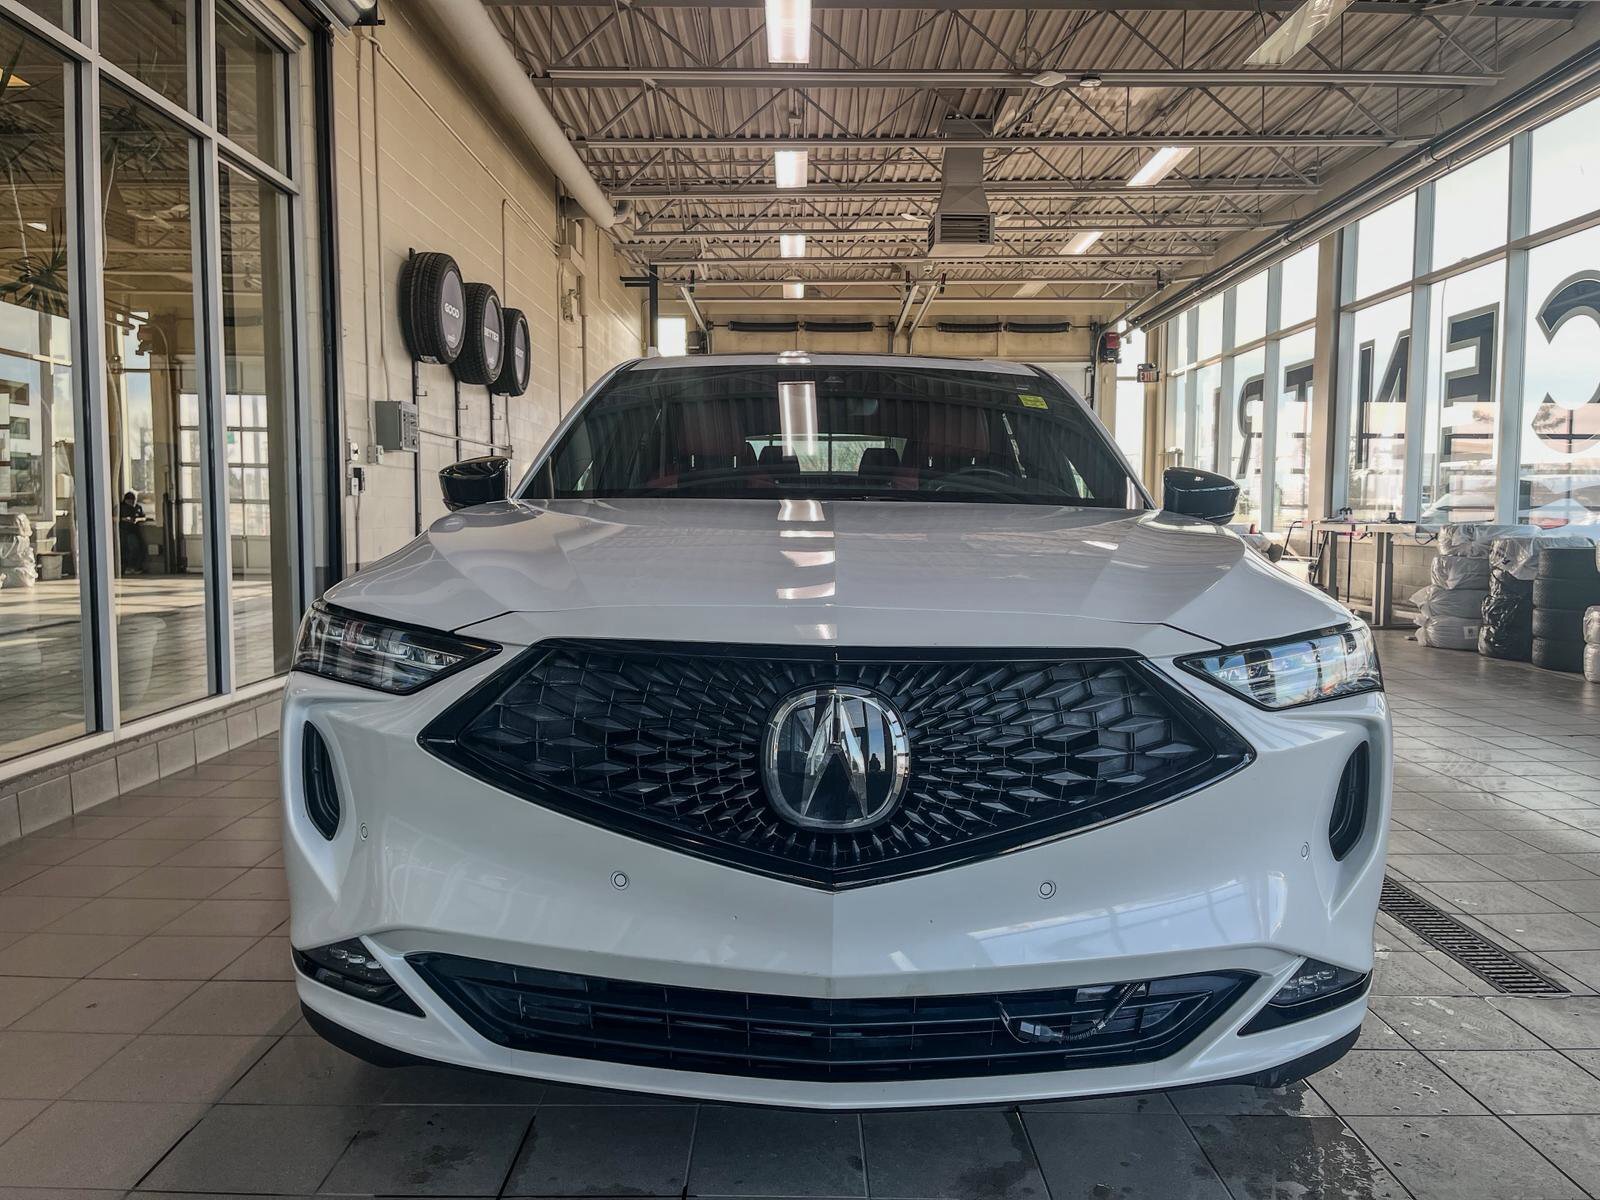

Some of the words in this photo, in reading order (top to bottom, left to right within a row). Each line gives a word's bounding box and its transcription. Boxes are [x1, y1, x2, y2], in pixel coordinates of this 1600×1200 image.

[444, 302, 460, 319] GOOD
[484, 327, 500, 343] BETTER
[1140, 371, 1153, 381] EXIT
